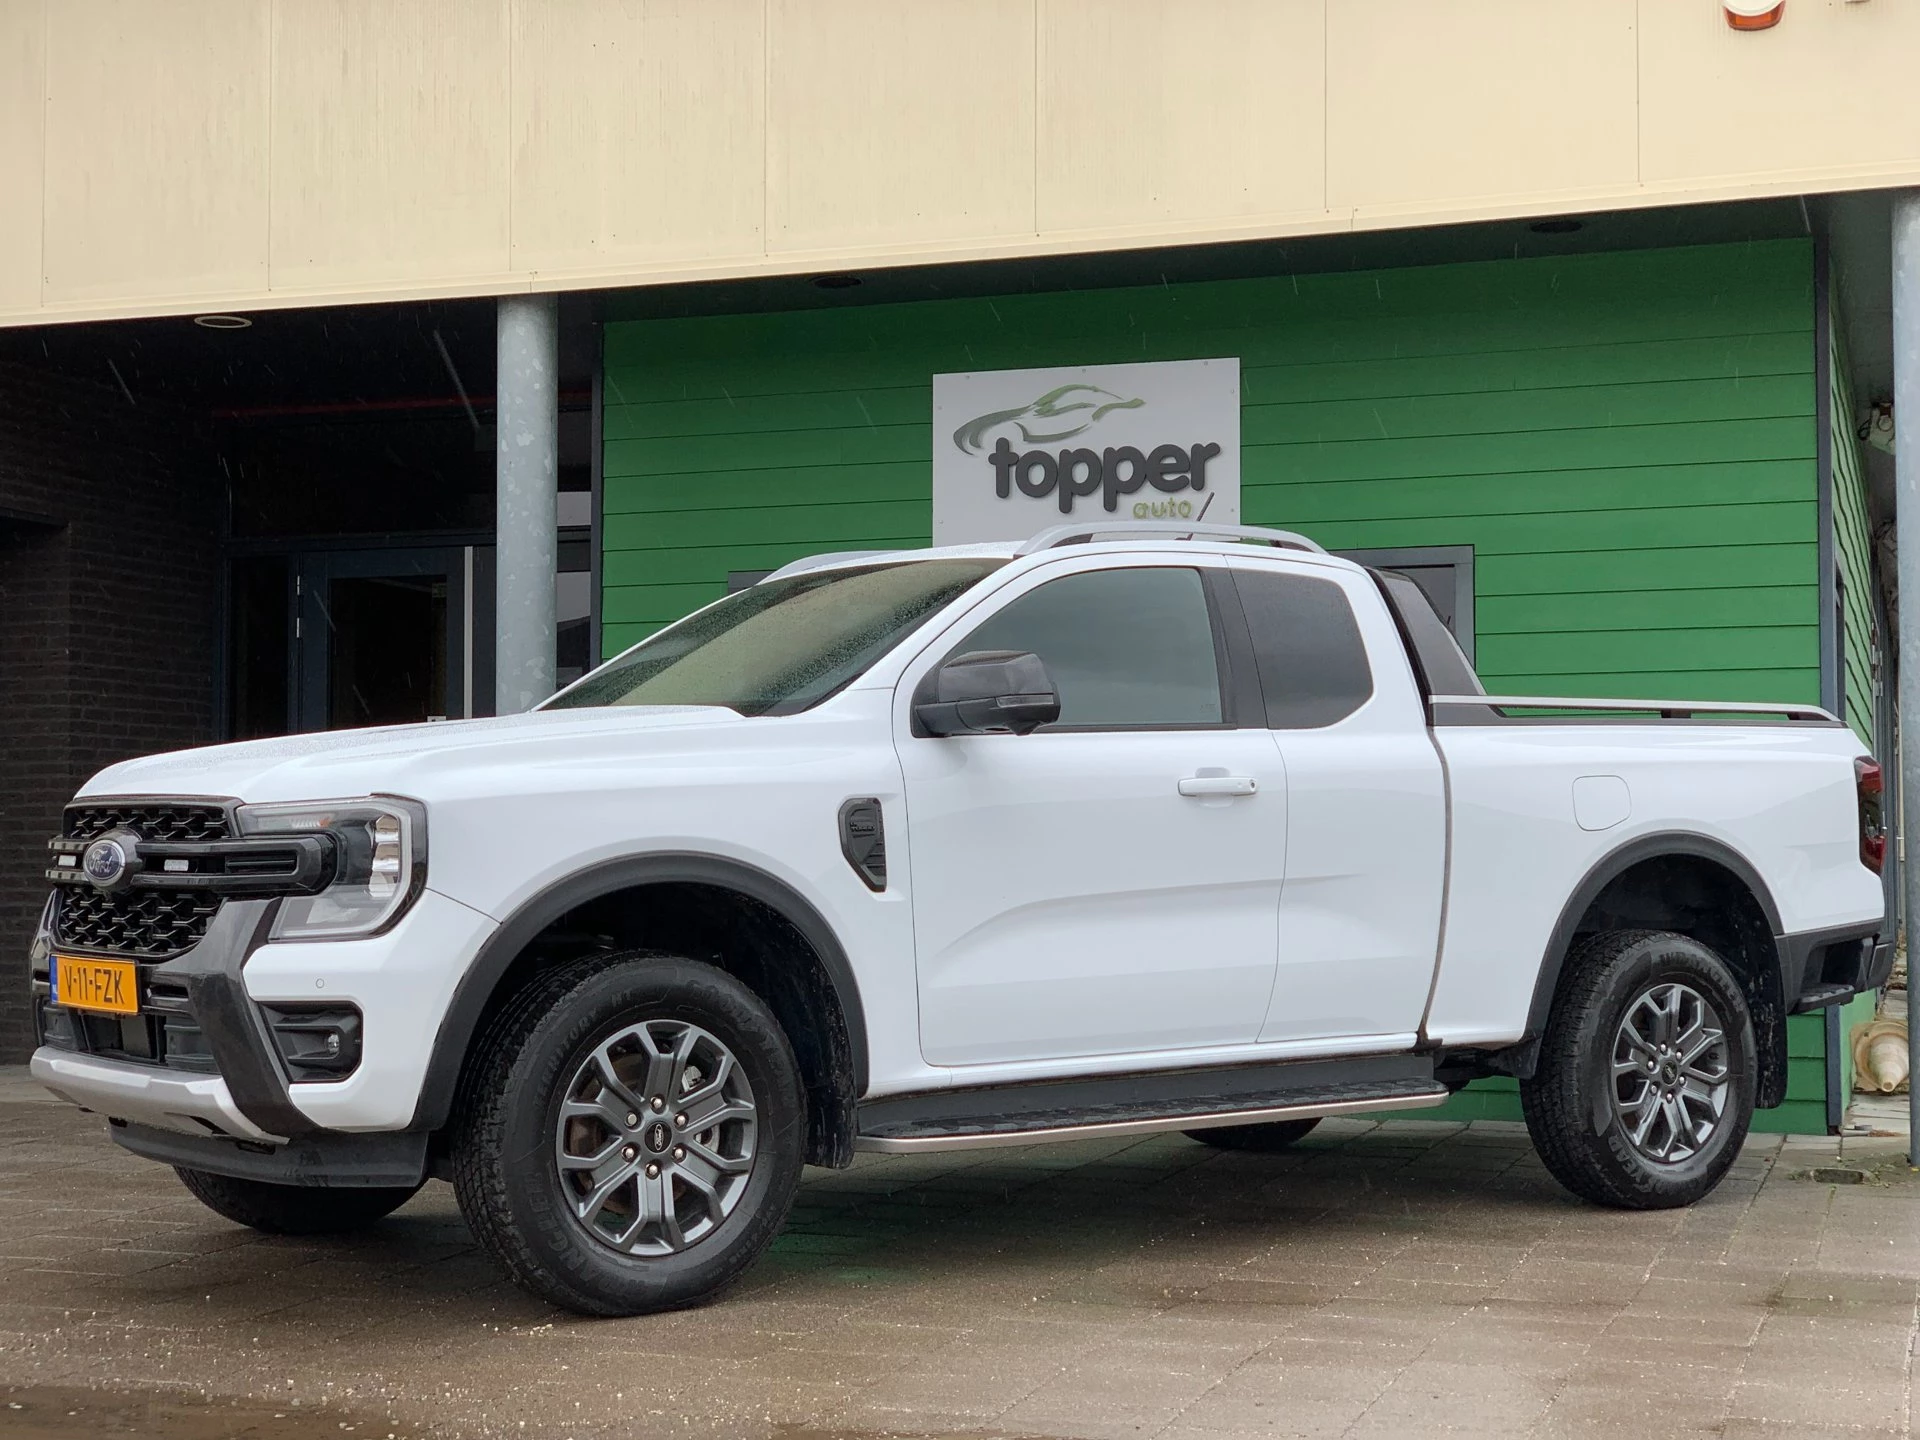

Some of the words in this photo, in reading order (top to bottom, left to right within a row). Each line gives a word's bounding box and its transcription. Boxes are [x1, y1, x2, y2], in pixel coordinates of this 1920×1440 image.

[988, 437, 1221, 514] topper
[1133, 497, 1192, 519] auto
[63, 964, 125, 1005] V-11-FZK
